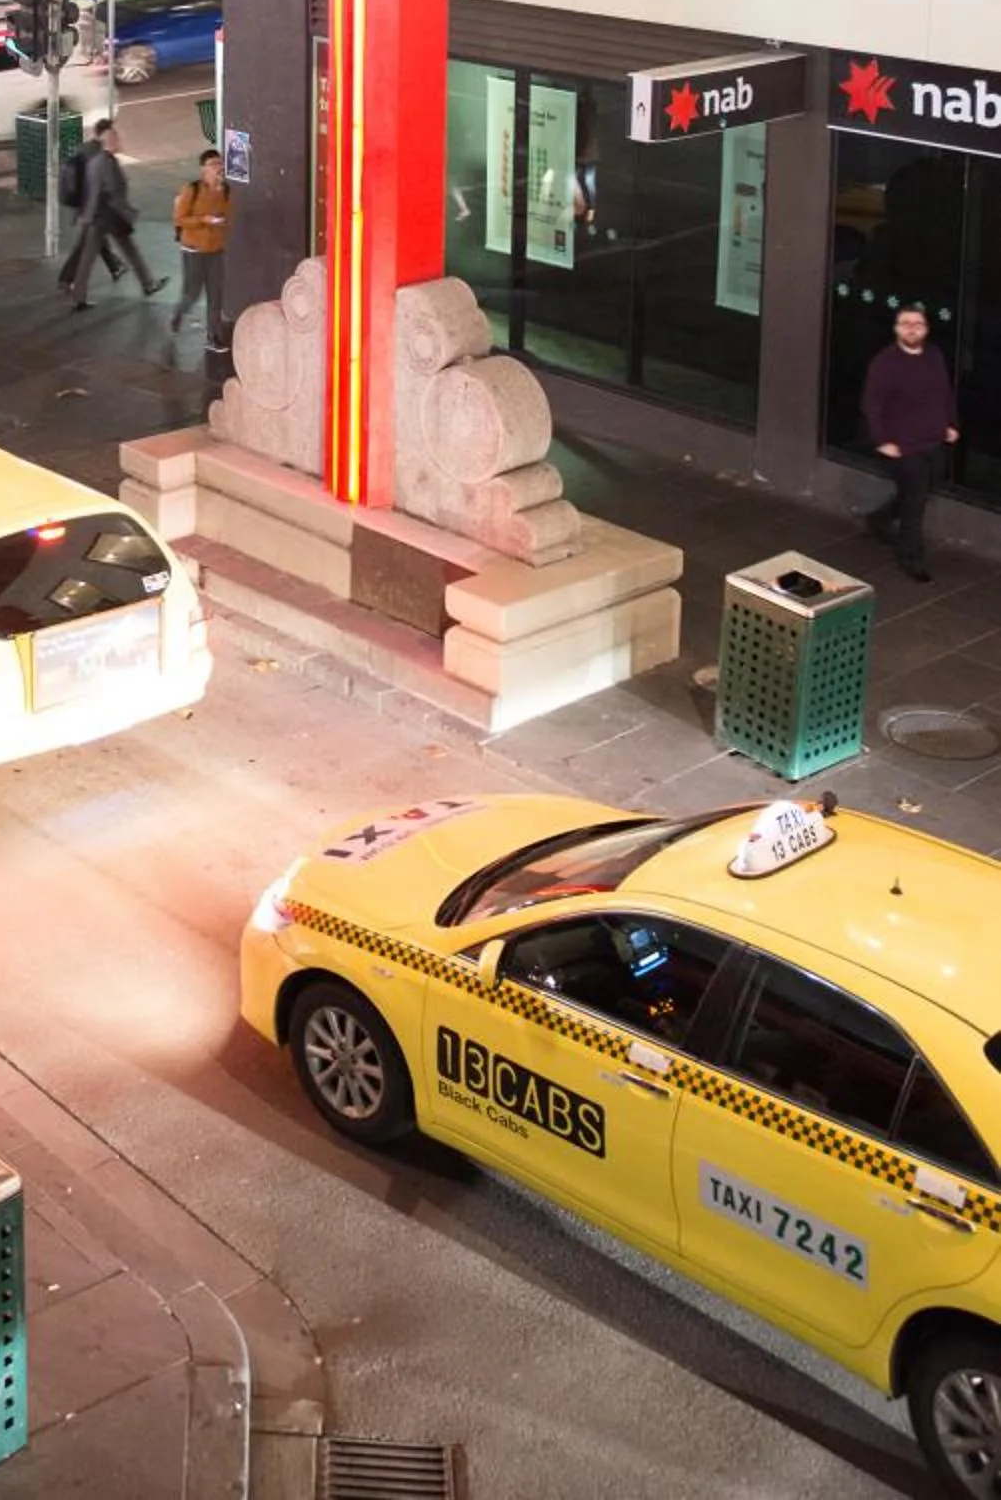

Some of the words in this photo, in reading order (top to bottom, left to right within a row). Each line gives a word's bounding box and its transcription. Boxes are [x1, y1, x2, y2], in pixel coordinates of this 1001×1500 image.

[702, 76, 753, 116] nab
[911, 80, 1001, 128] nab
[772, 840, 786, 861] 13
[788, 823, 818, 853] CABS
[776, 809, 805, 834] TAXI
[438, 1079, 483, 1116] Black
[486, 1104, 530, 1139] Cabs
[440, 1030, 603, 1153] 13CABS
[710, 1176, 763, 1224] TAXI
[772, 1205, 865, 1281] 7242
